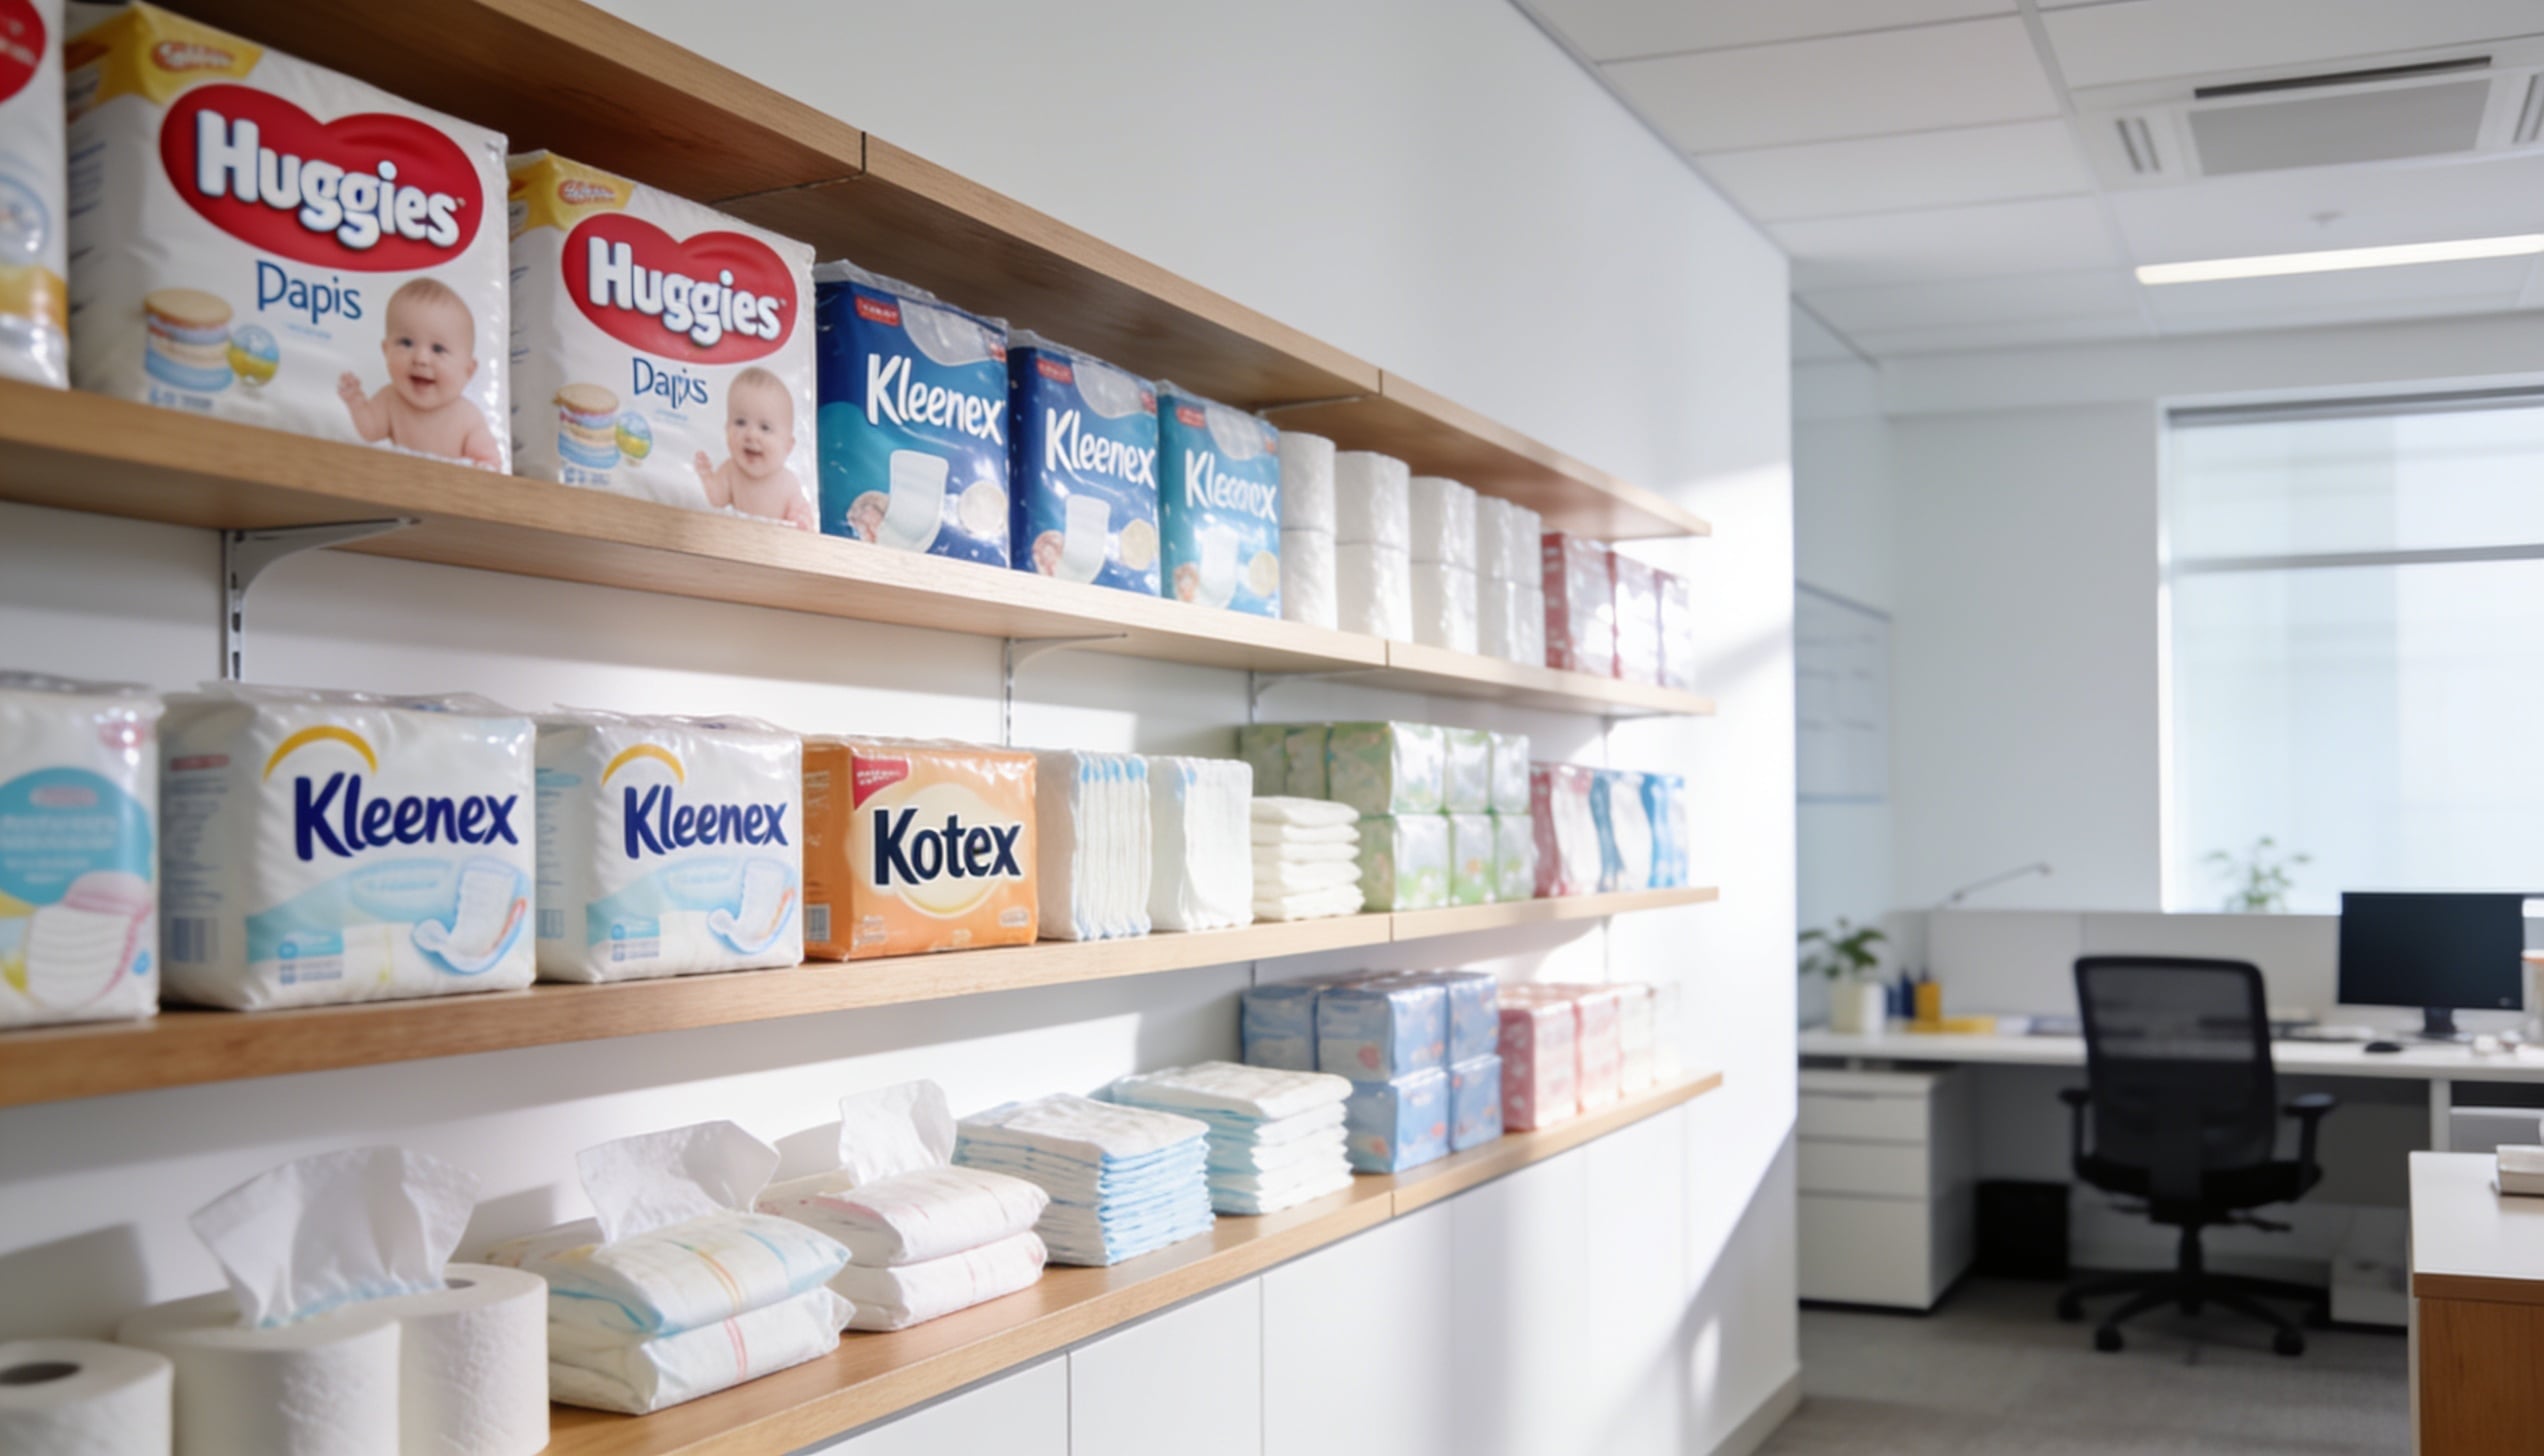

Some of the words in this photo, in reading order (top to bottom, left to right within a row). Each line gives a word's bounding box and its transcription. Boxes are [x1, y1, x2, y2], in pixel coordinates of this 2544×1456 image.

[196, 109, 461, 249] Huggies
[588, 236, 782, 347] Huggies
[866, 353, 1004, 445] Kleenex
[1045, 408, 1157, 489] Kleenex
[294, 771, 520, 862] Kleenex
[623, 783, 789, 860] Kleenex
[873, 807, 1022, 886] Kotex
